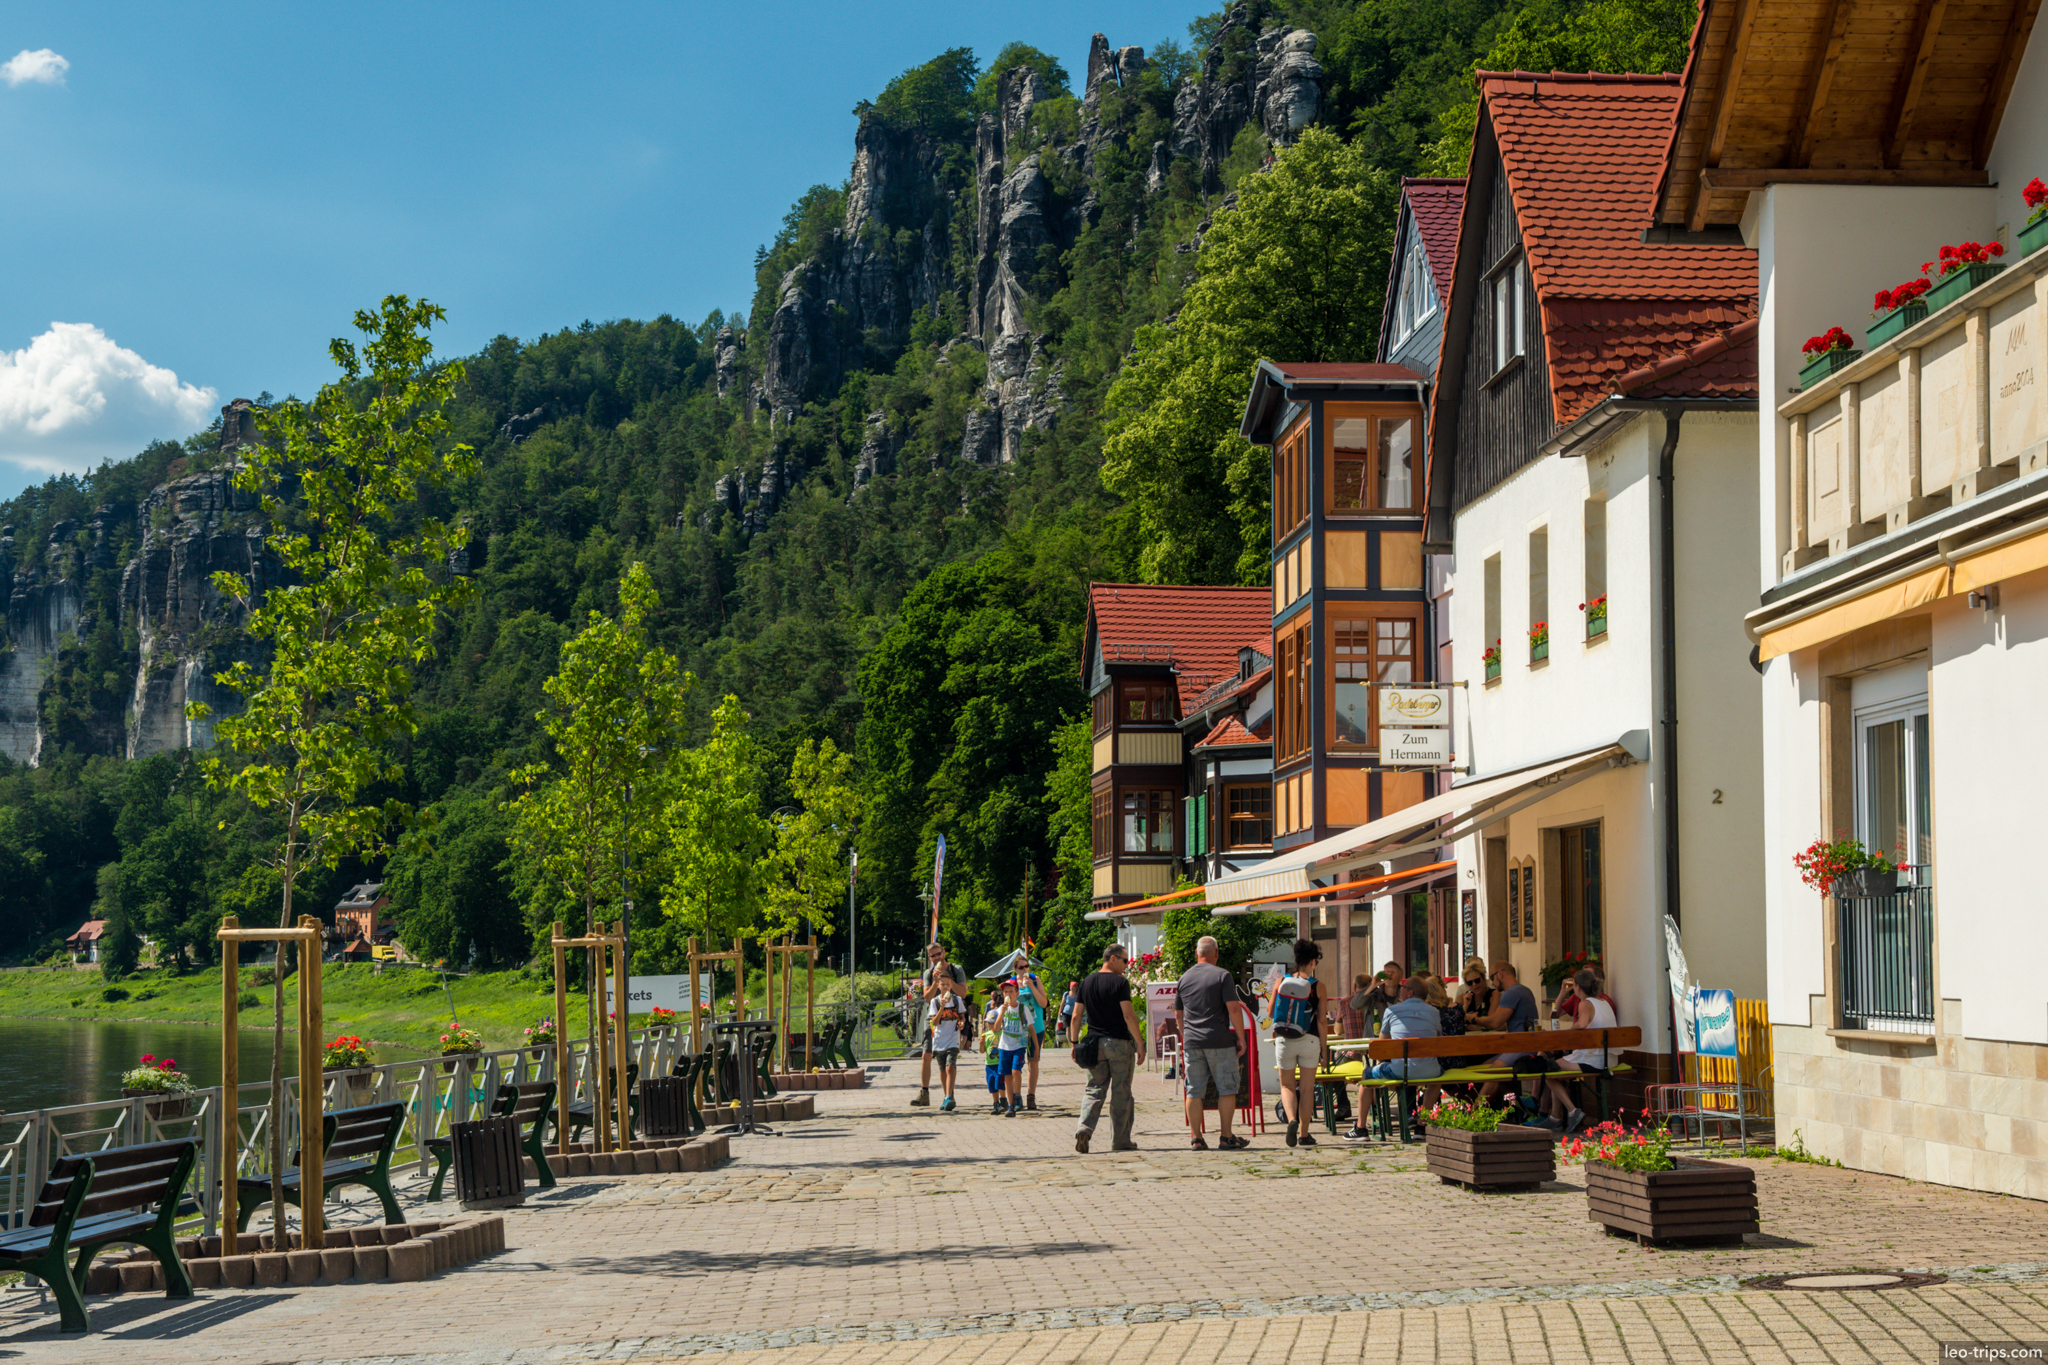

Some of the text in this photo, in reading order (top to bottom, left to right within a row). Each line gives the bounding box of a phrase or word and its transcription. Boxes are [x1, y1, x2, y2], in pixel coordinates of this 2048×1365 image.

[1388, 692, 1440, 714] Radeberger
[1402, 733, 1428, 745] Zum
[1390, 749, 1441, 760] Hermann
[1712, 788, 1723, 804] 2
[606, 990, 653, 1002] Tkets
